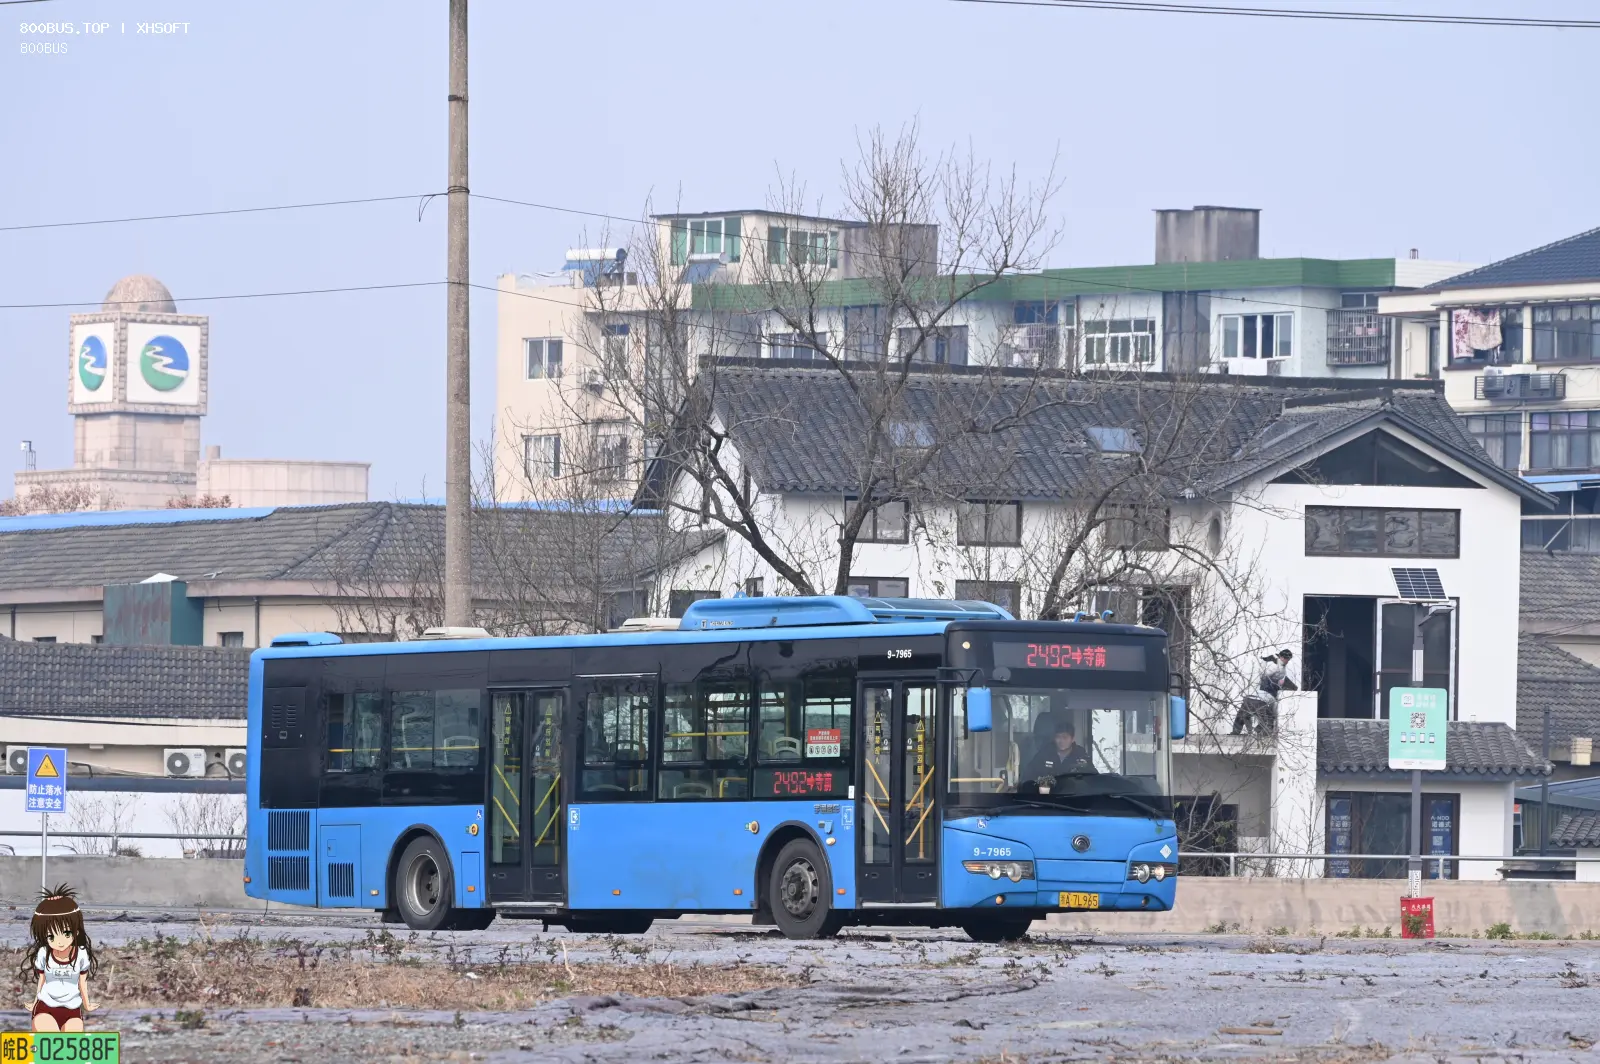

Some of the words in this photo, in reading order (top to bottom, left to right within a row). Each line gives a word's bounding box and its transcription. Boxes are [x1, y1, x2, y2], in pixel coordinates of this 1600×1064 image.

[887, 649, 912, 659] 9-7965
[28, 783, 63, 796] 防止落水
[28, 797, 62, 809] 注意安全
[973, 847, 1012, 857] 9-7965
